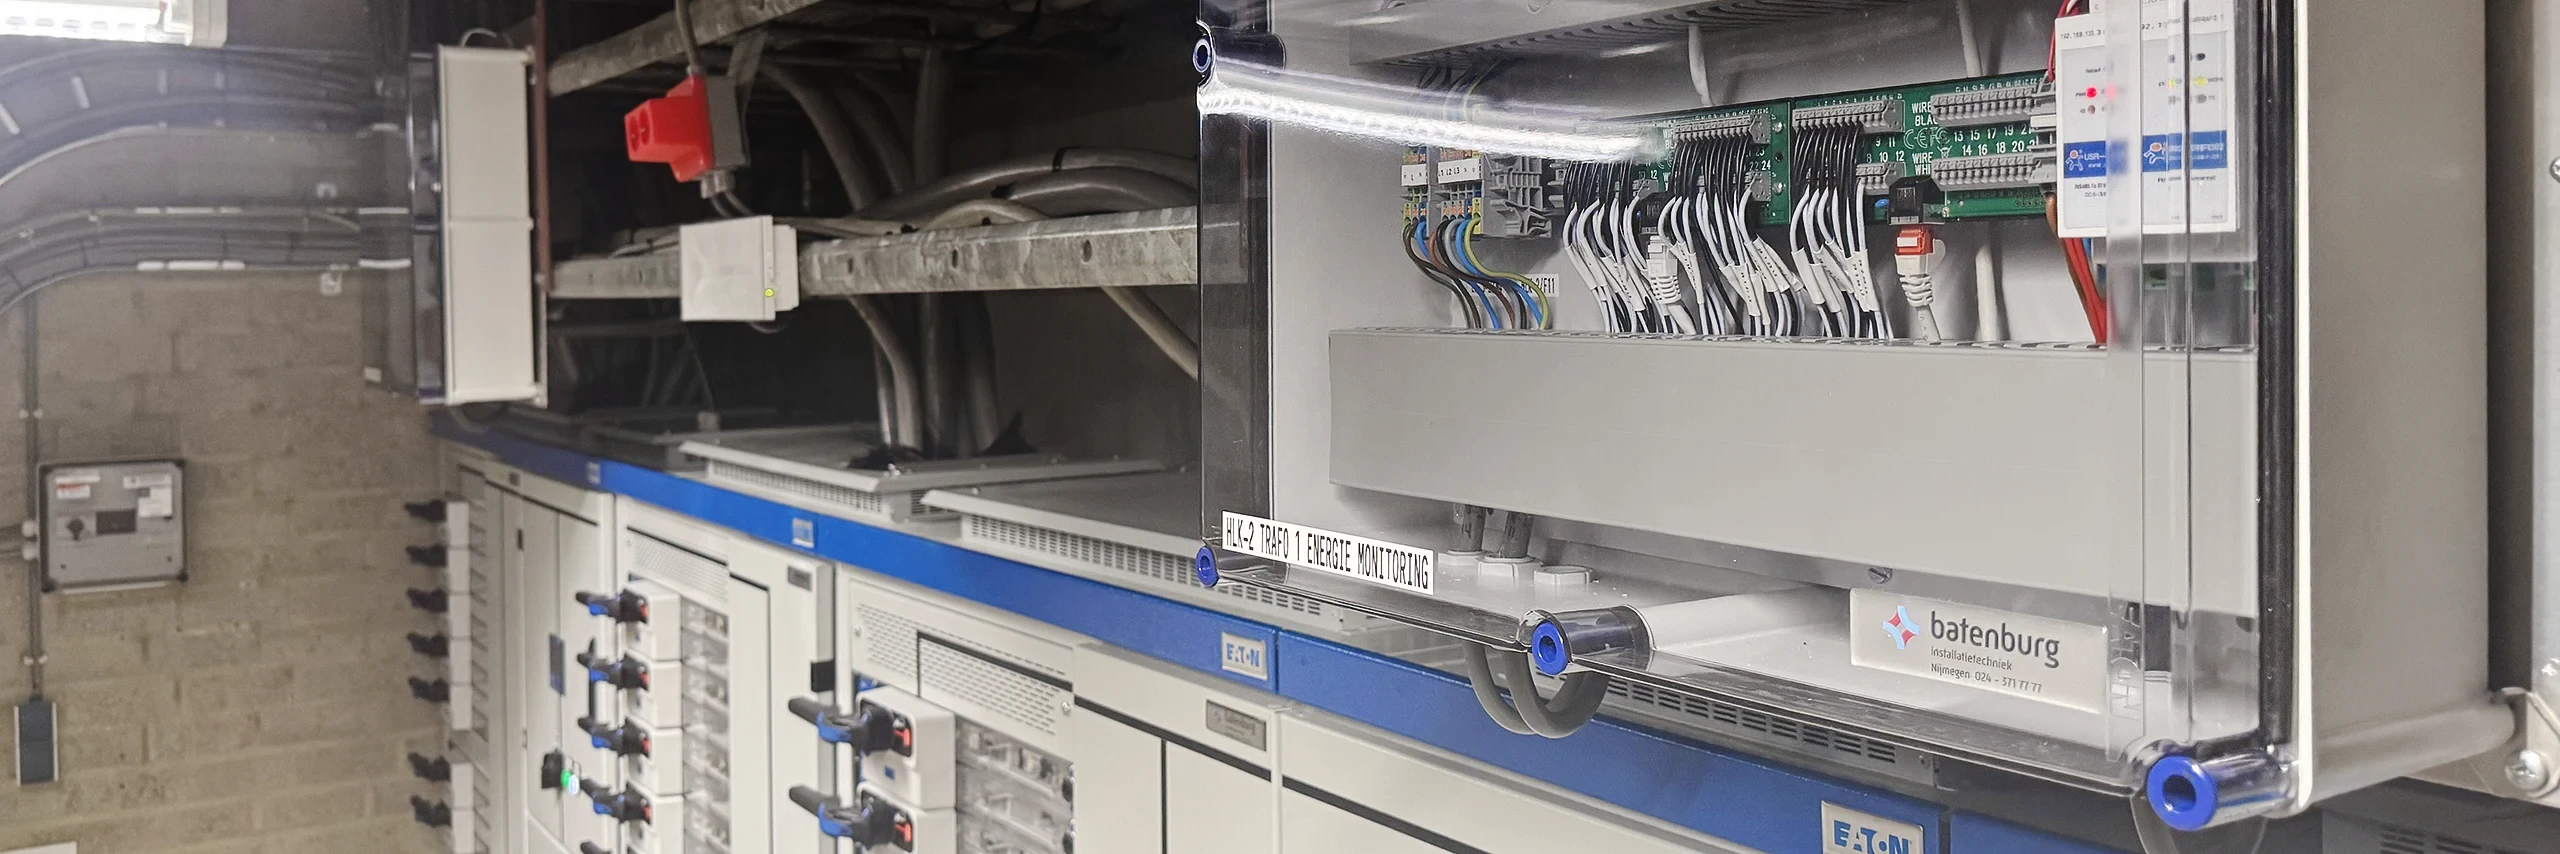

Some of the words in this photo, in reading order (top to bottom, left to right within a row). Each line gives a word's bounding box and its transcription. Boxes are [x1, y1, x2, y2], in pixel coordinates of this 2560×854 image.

[1888, 136, 1896, 147] 11
[1970, 129, 1980, 140] 15
[1987, 127, 1997, 139] 17
[2004, 125, 2014, 136] 19
[1866, 153, 1873, 163] 8
[1879, 151, 1888, 163] 10
[1895, 150, 1905, 162] 12
[1962, 144, 1972, 156] 14
[1978, 144, 1988, 155] 16
[1996, 141, 2006, 153] 18
[2012, 140, 2025, 152] 20
[1761, 159, 1772, 171] 24
[1226, 516, 1255, 551] HLK-2
[1260, 523, 1289, 559] TRAFO
[1295, 530, 1300, 561] 1
[1307, 533, 1351, 572] ENERGIE
[1357, 542, 1429, 590] MONITORING
[1930, 610, 2060, 669] batenburg
[1931, 645, 2013, 671] installatietechniek
[1931, 662, 1971, 680] Nijmegen
[1974, 671, 1992, 683] 024
[2002, 676, 2016, 689] 371
[2018, 678, 2030, 691] 77
[2032, 682, 2042, 693] 77
[1833, 819, 1909, 854] EATON
